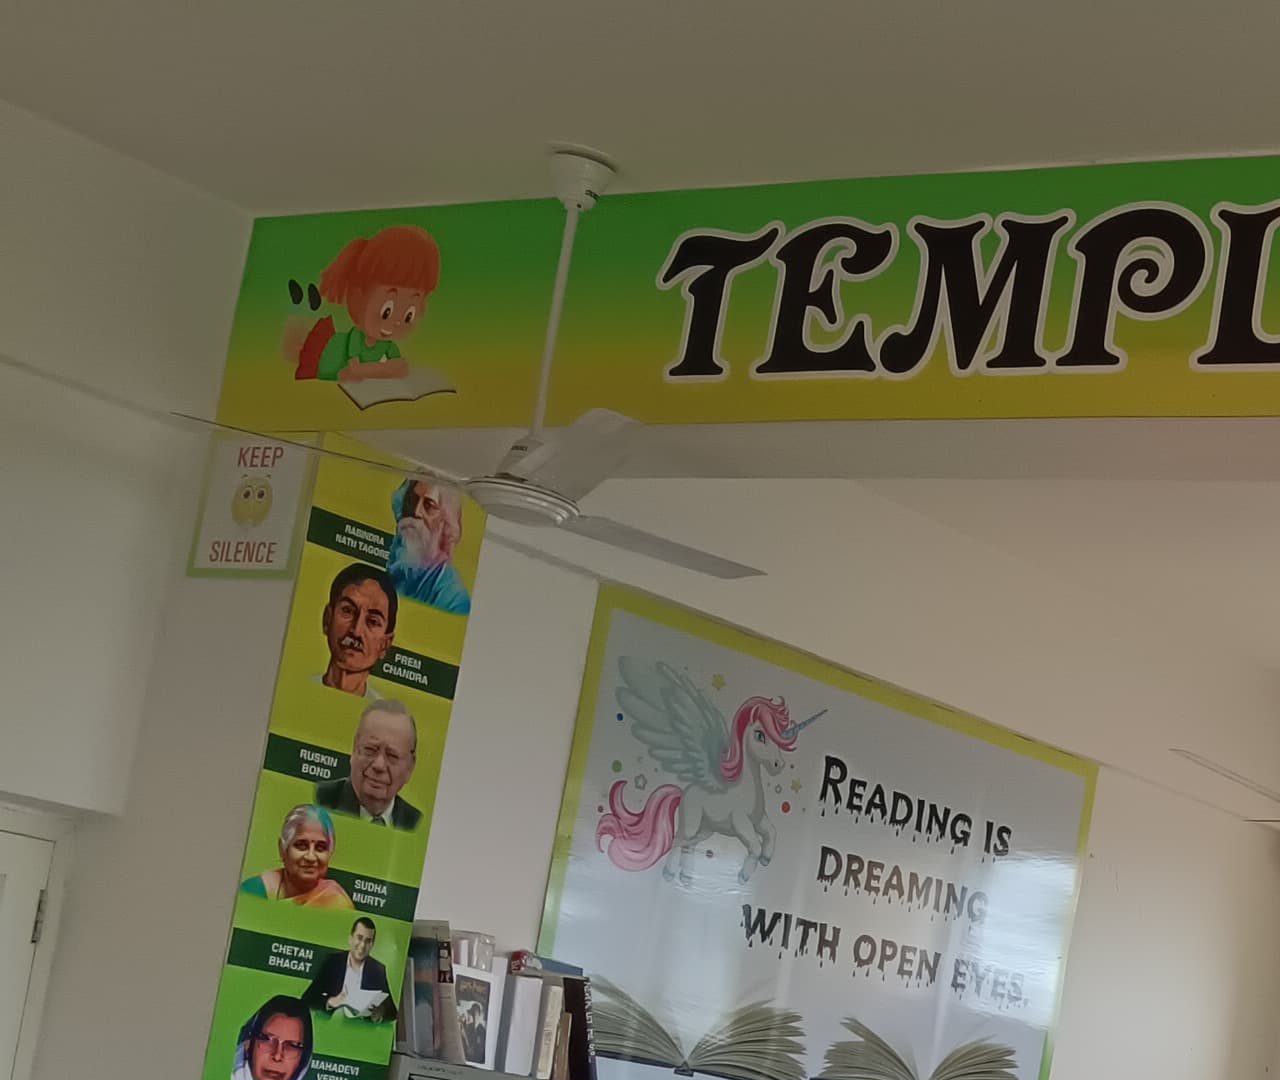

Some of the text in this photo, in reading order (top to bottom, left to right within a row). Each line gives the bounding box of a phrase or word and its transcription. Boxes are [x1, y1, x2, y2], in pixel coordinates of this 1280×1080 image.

[238, 446, 284, 468] KEEP
[344, 524, 385, 546] RABINDRA
[209, 540, 277, 564] SILENCE
[358, 539, 391, 559] TAGORE
[394, 653, 422, 670] PREM
[383, 663, 428, 686] CHANDRA
[299, 748, 338, 768] RUSKIN
[301, 763, 332, 780] BOND
[818, 755, 1013, 862] READING IS
[354, 878, 388, 896] SUDHA
[816, 846, 989, 931] DREAMING
[352, 890, 387, 910] MURTY
[271, 941, 314, 960] CHETAN
[740, 903, 842, 967] WITH
[853, 934, 942, 988] OPEN
[268, 954, 313, 974] BHAGAT
[310, 1058, 359, 1077] MAHADEVI
